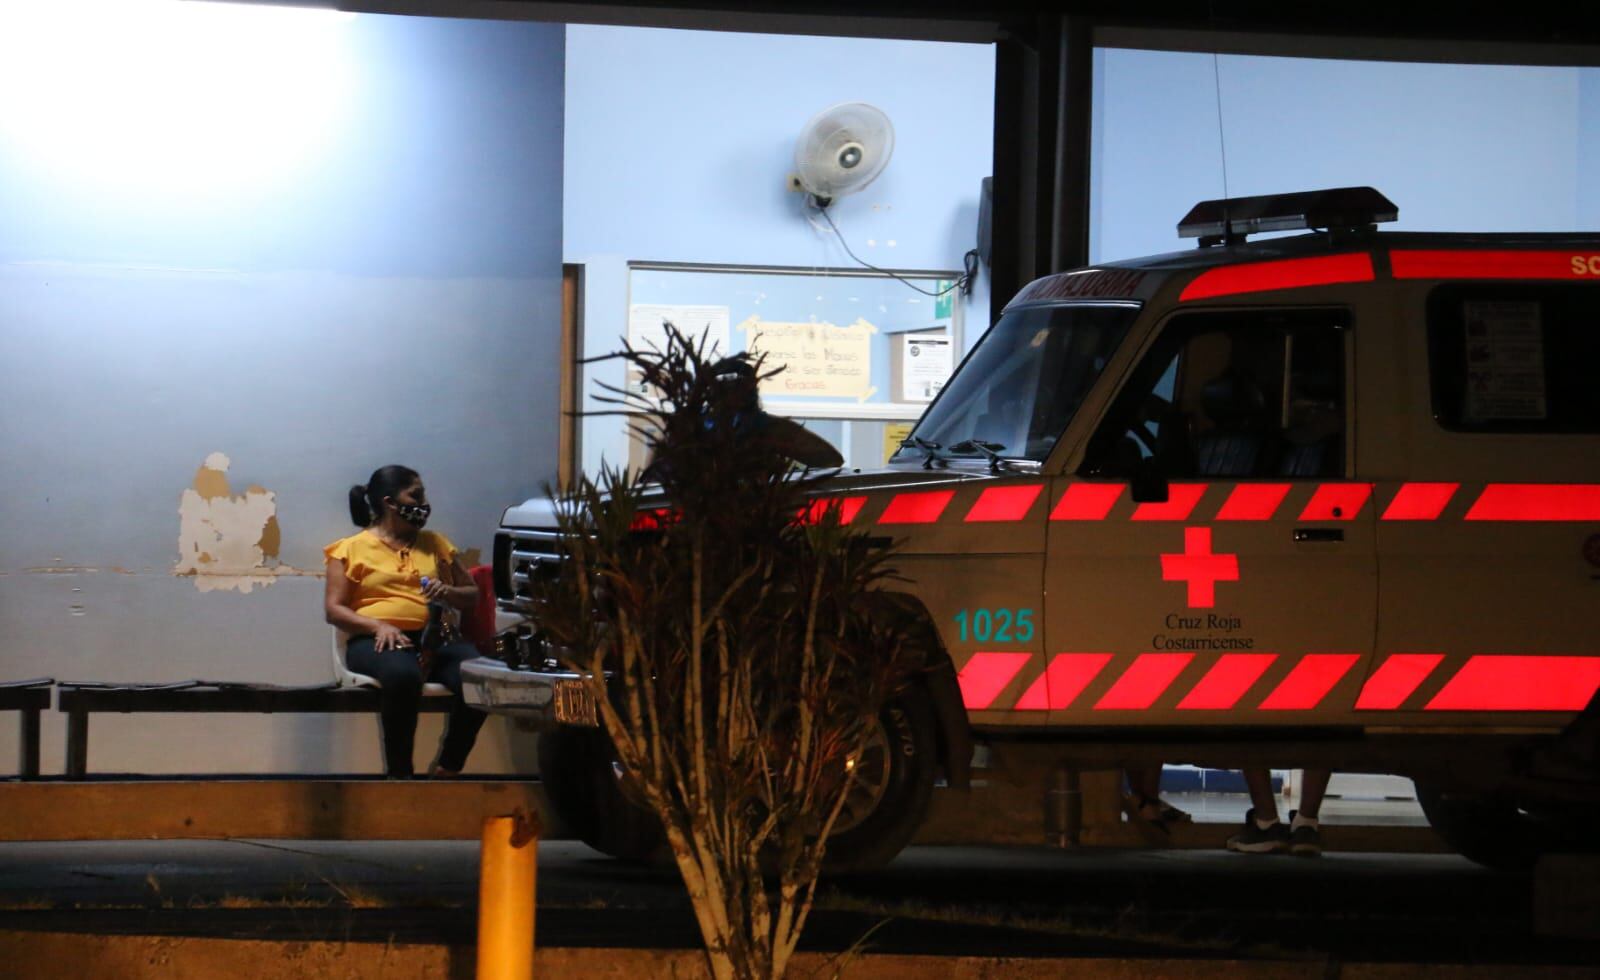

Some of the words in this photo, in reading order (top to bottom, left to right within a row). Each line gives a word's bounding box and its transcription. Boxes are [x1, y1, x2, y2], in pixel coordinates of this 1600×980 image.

[953, 608, 1034, 643] 1025
[1165, 613, 1202, 629] Cruz
[1207, 612, 1241, 632] Roja
[1152, 633, 1254, 650] Costarricense
